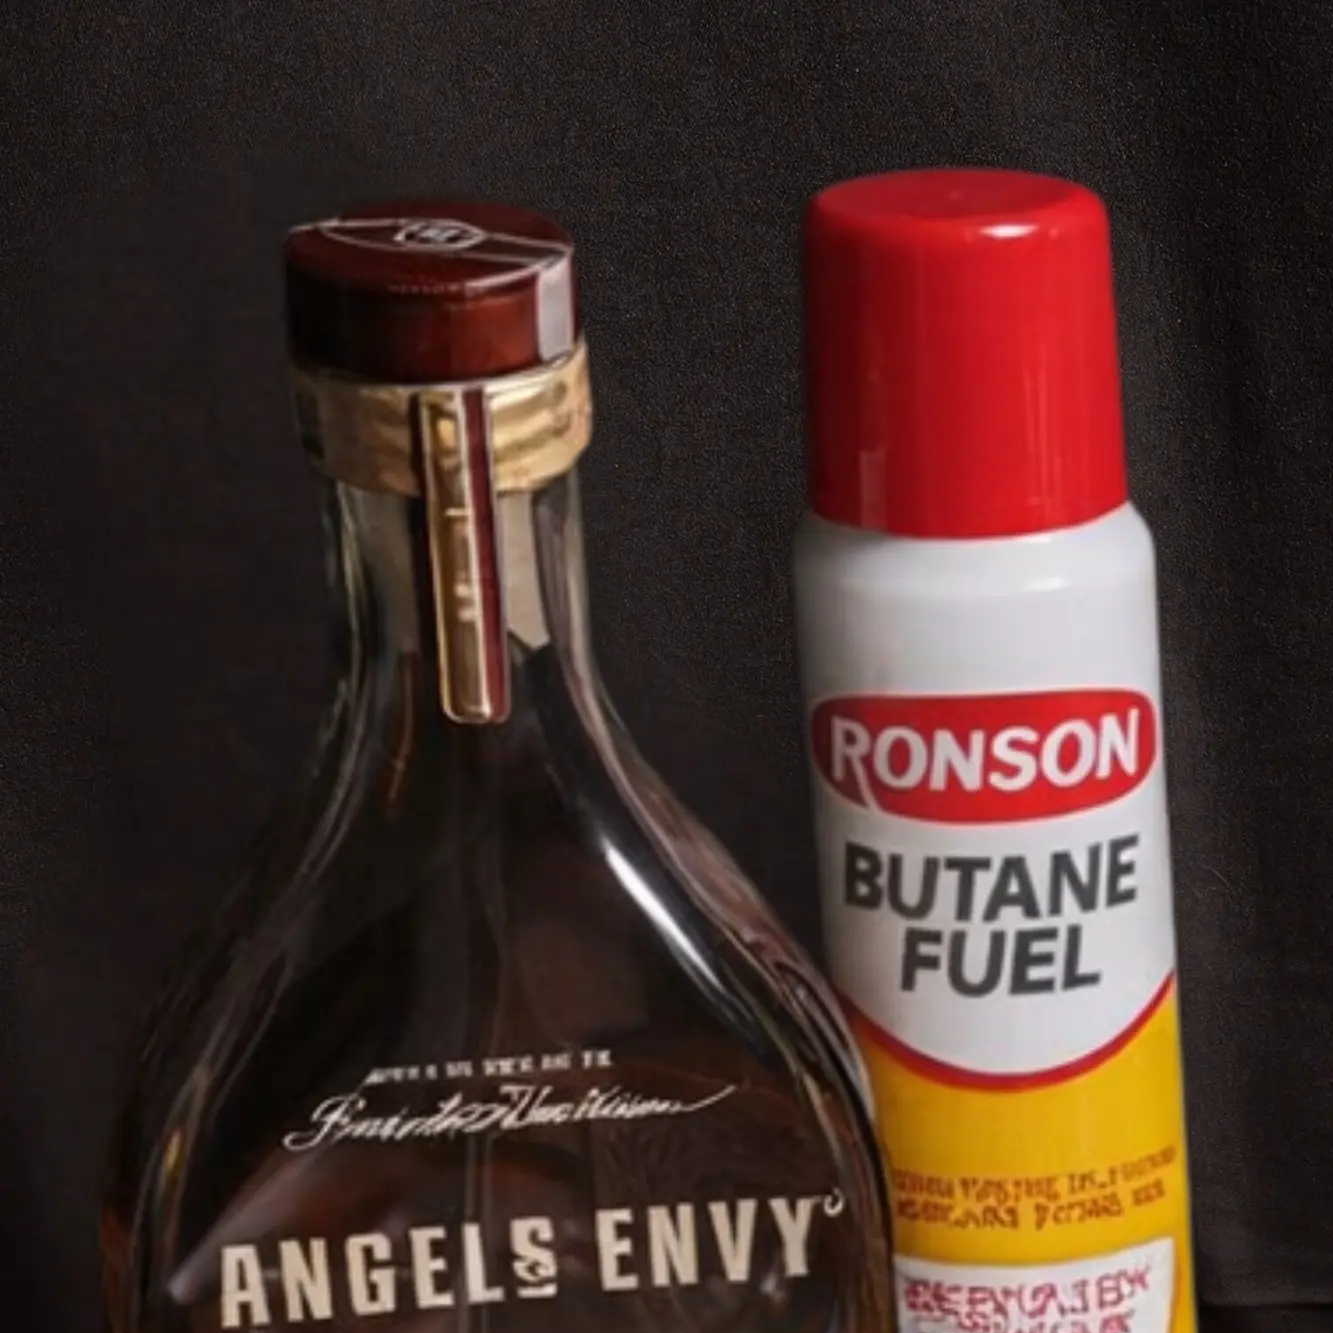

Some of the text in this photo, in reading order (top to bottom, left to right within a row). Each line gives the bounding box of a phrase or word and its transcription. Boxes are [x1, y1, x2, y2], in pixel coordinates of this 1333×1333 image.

[829, 708, 1140, 806] RONSON
[843, 833, 1139, 923] BUTANE
[900, 924, 1103, 999] FUEL
